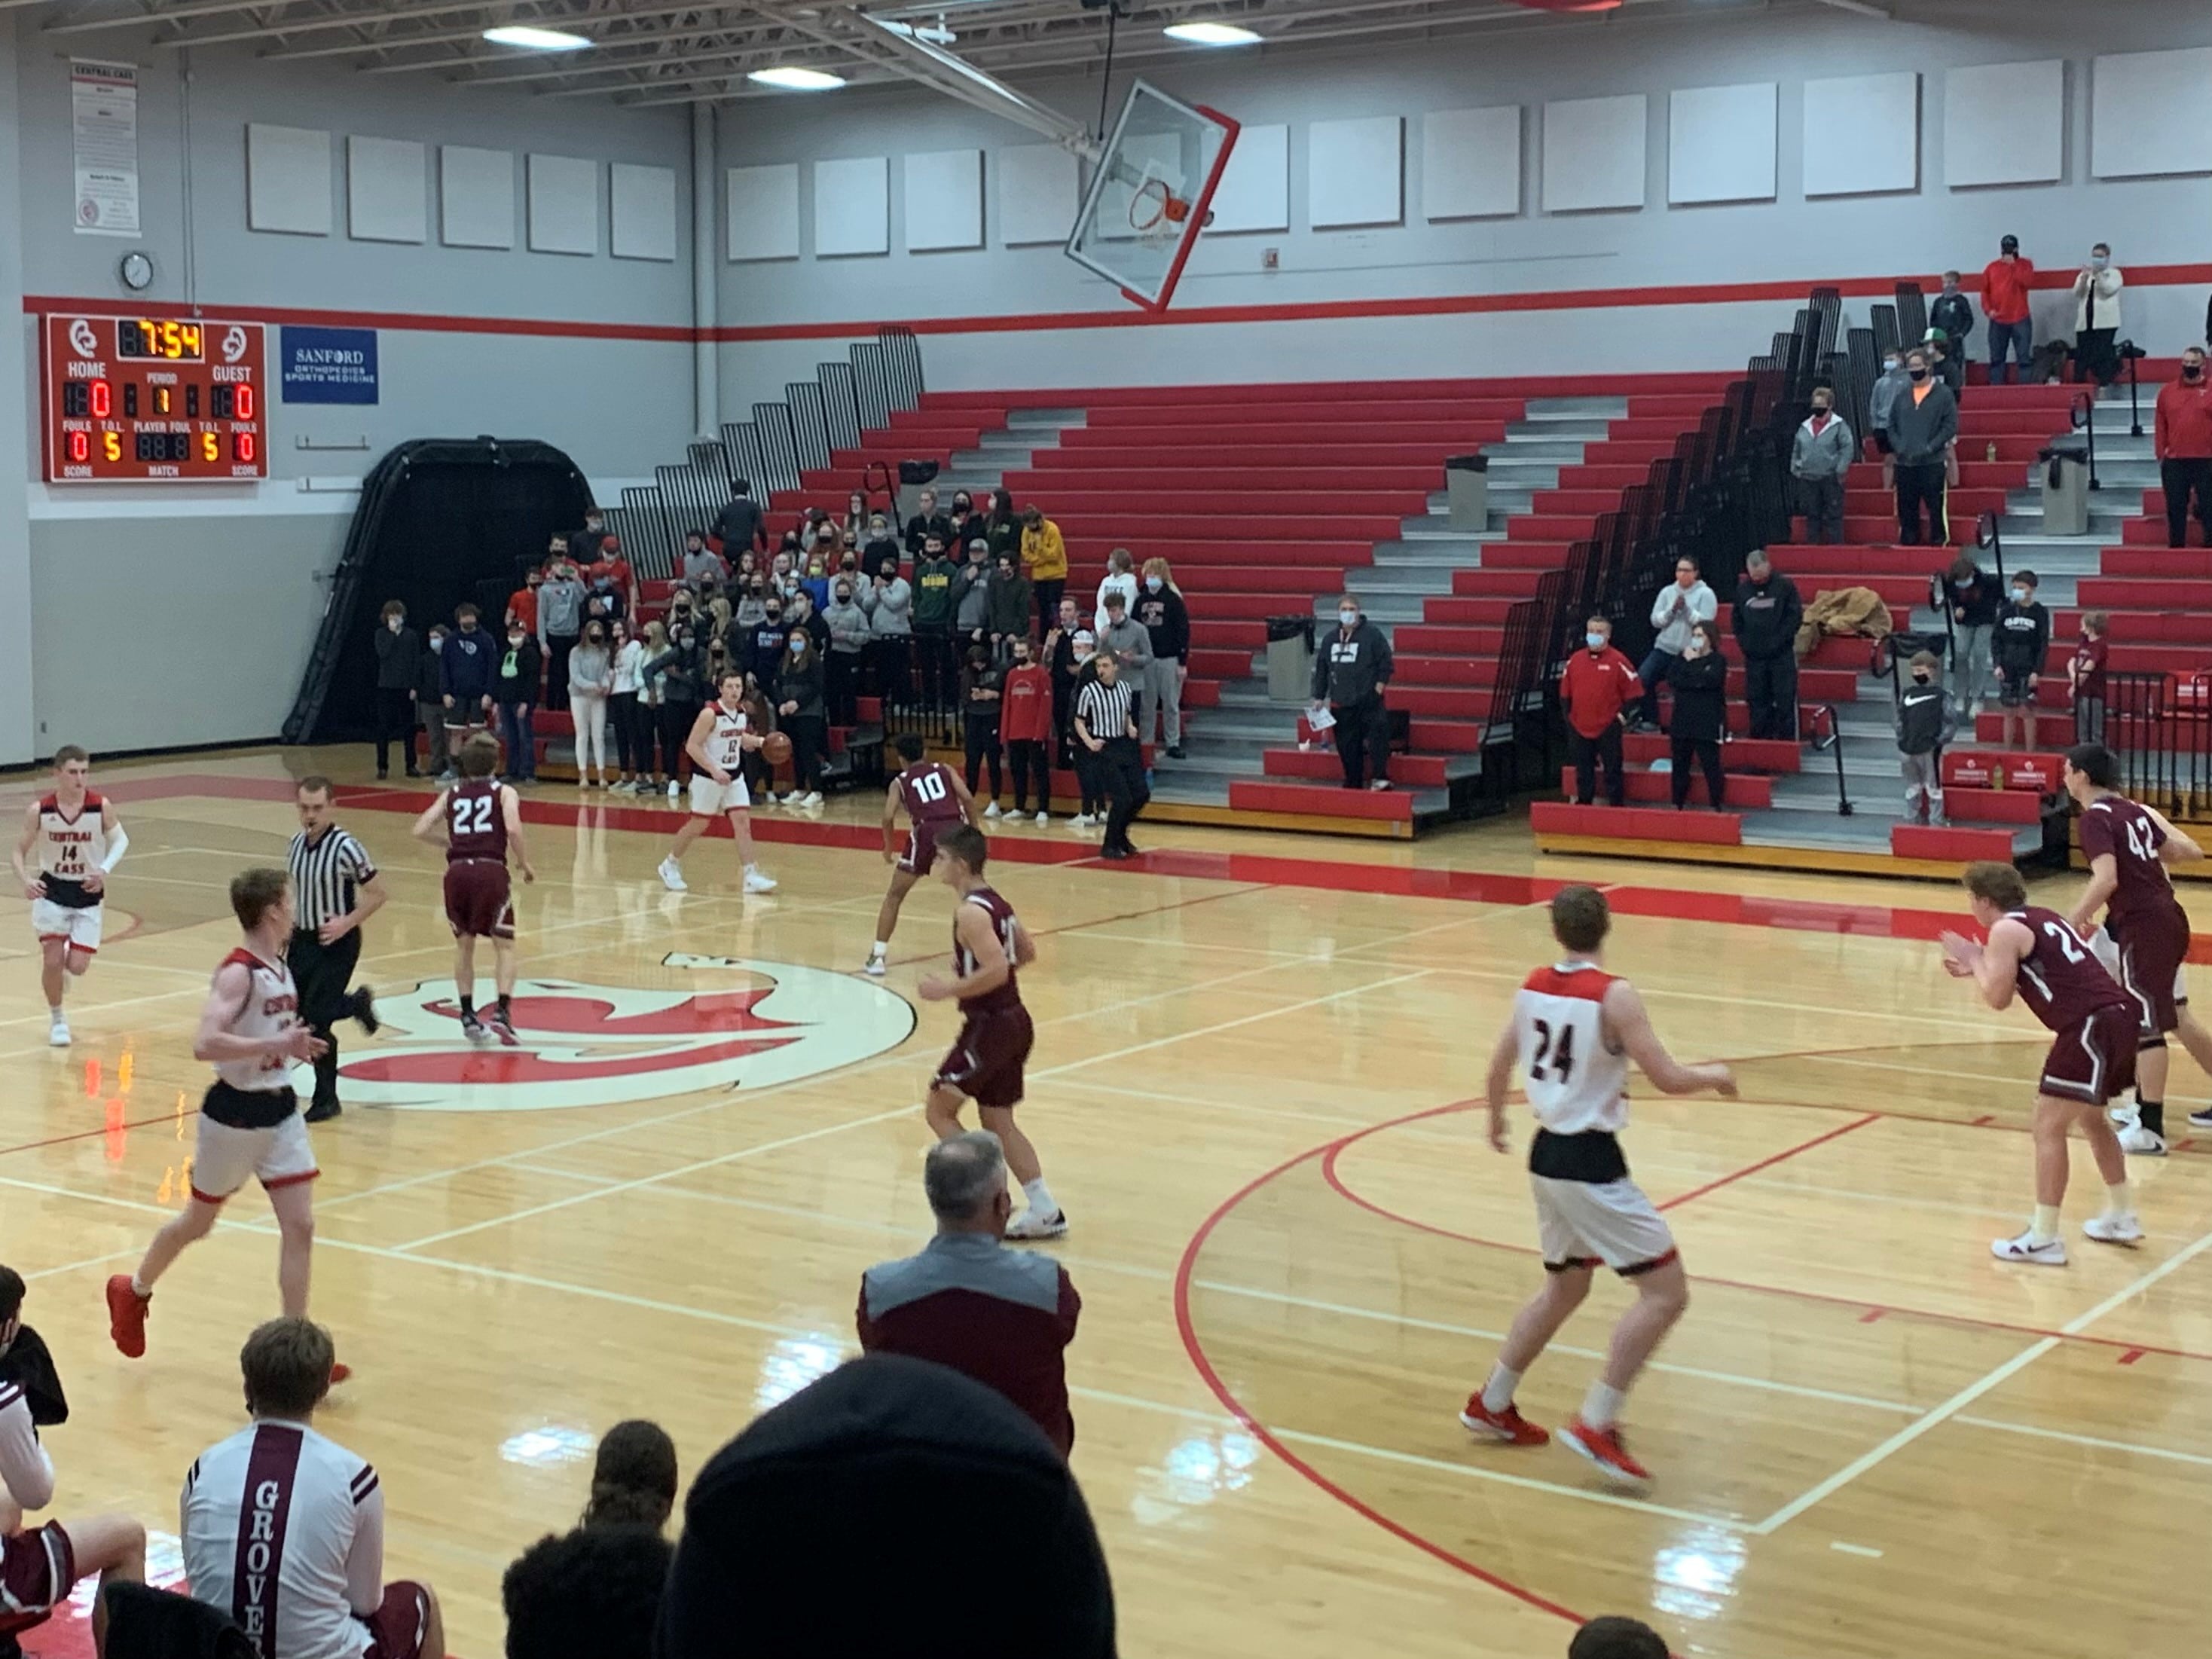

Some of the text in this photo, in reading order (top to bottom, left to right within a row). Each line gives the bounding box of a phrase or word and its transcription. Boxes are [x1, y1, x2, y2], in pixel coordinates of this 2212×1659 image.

[139, 319, 200, 359] 7:54
[295, 348, 363, 365] SANFORD
[68, 361, 107, 378] HOME
[212, 365, 252, 383] GUEST
[285, 373, 375, 383] SPORTS MEDICINE
[92, 381, 110, 417] 0
[237, 383, 253, 420] 0
[62, 420, 92, 432] FOULS
[133, 420, 191, 433] PLAYER FOUL
[231, 422, 258, 434] FOULS
[73, 432, 87, 462] 0
[105, 432, 121, 461] 5
[203, 432, 218, 462] 5
[240, 433, 254, 461] 0
[63, 465, 93, 478] SCORE
[148, 466, 179, 477] MATCH
[231, 466, 258, 476] SCORE
[911, 771, 946, 803] 10
[452, 796, 493, 833] 22
[49, 831, 92, 842] CENTRAL
[2125, 816, 2159, 862] 42
[62, 845, 78, 861] 14
[54, 862, 85, 874] CASS
[1530, 1019, 1575, 1085] 24
